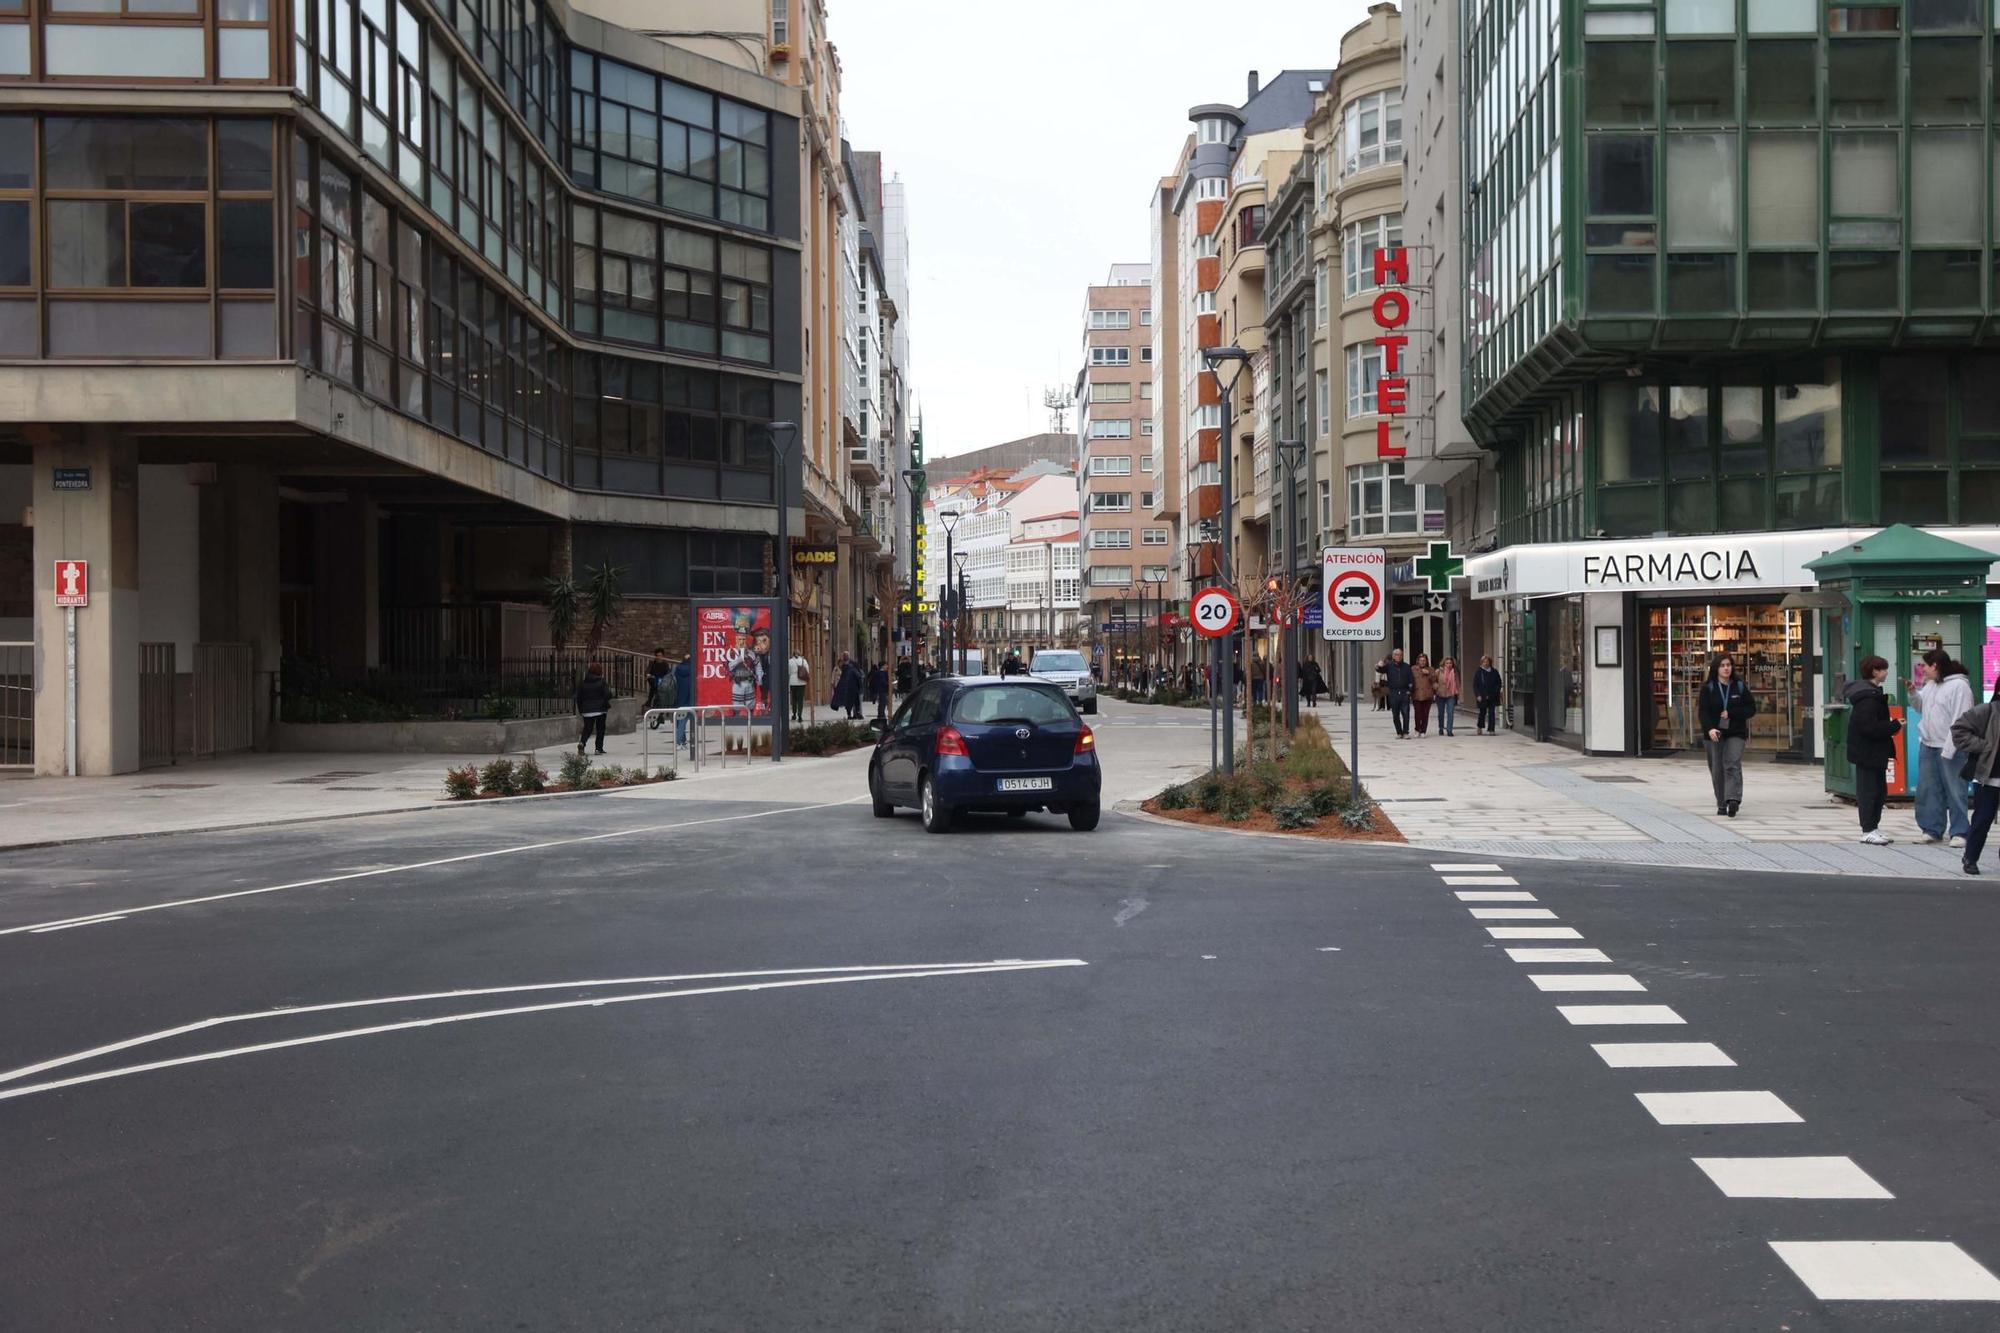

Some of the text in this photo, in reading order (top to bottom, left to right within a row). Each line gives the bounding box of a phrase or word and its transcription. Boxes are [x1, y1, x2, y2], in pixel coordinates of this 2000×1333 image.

[1372, 247, 1410, 457] HOTEL
[55, 480, 88, 488] PONTEVEDRA
[795, 551, 836, 563] GADIS
[916, 524, 927, 597] HOTEL
[1325, 553, 1383, 563] ATENCIÓN
[1584, 550, 1760, 584] FARMACIA
[57, 596, 85, 604] HIDRANTE
[902, 602, 937, 612] NDO
[1200, 604, 1227, 620] 20
[703, 631, 726, 646] EN
[1005, 779, 1050, 789] 0514 GJH
